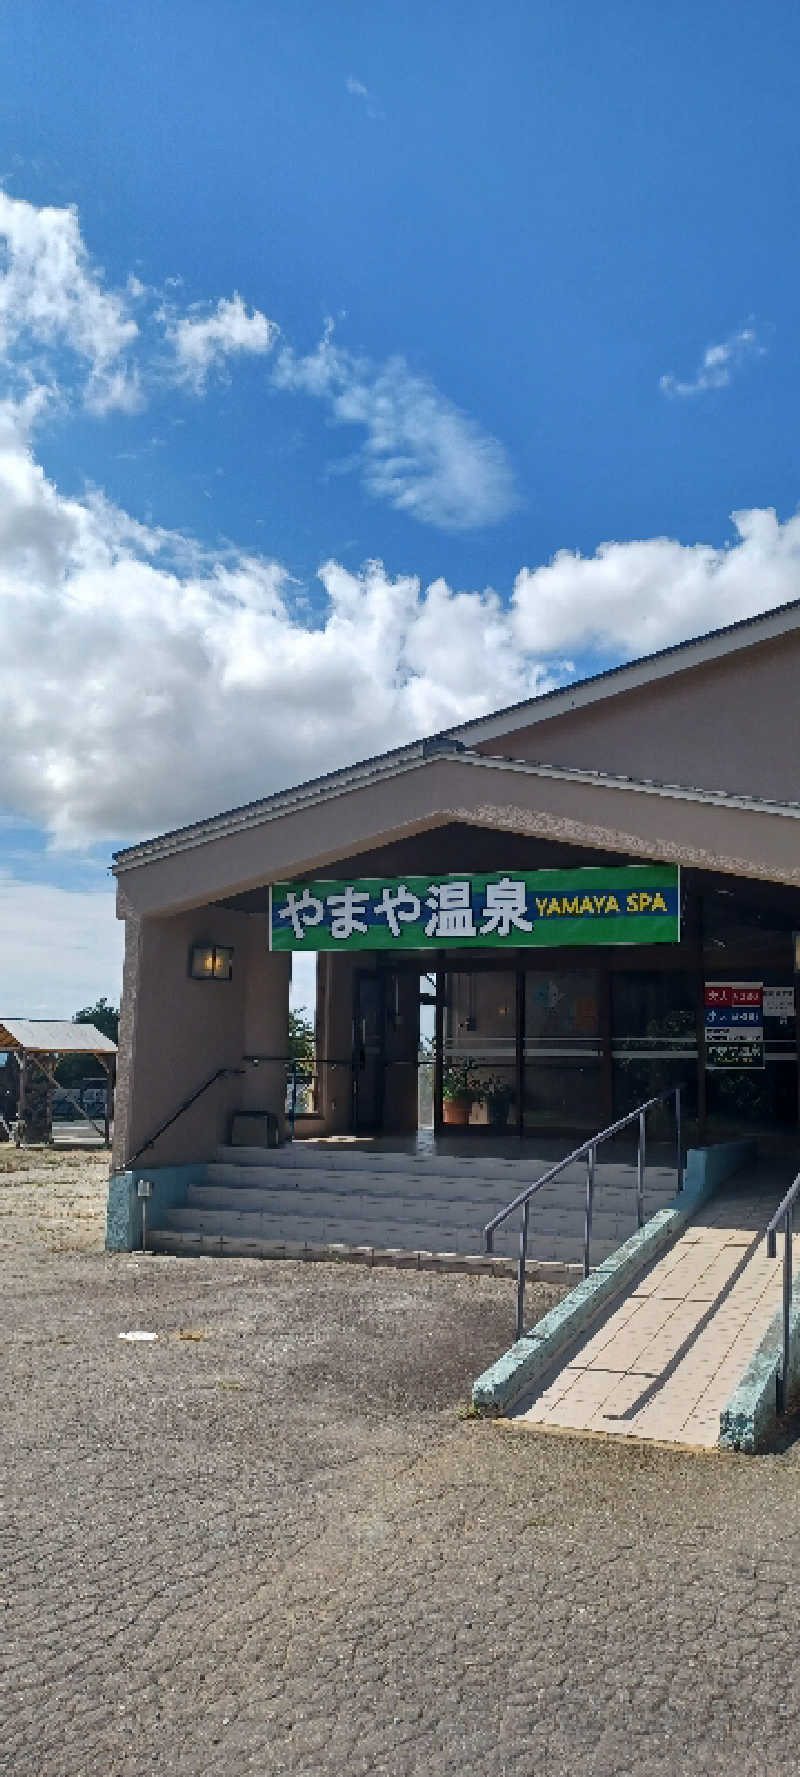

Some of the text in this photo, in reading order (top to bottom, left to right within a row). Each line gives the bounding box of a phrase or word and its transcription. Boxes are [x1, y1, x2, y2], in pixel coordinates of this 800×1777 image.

[278, 878, 534, 939] やまや温泉
[535, 892, 668, 916] YAMAYA SPA
